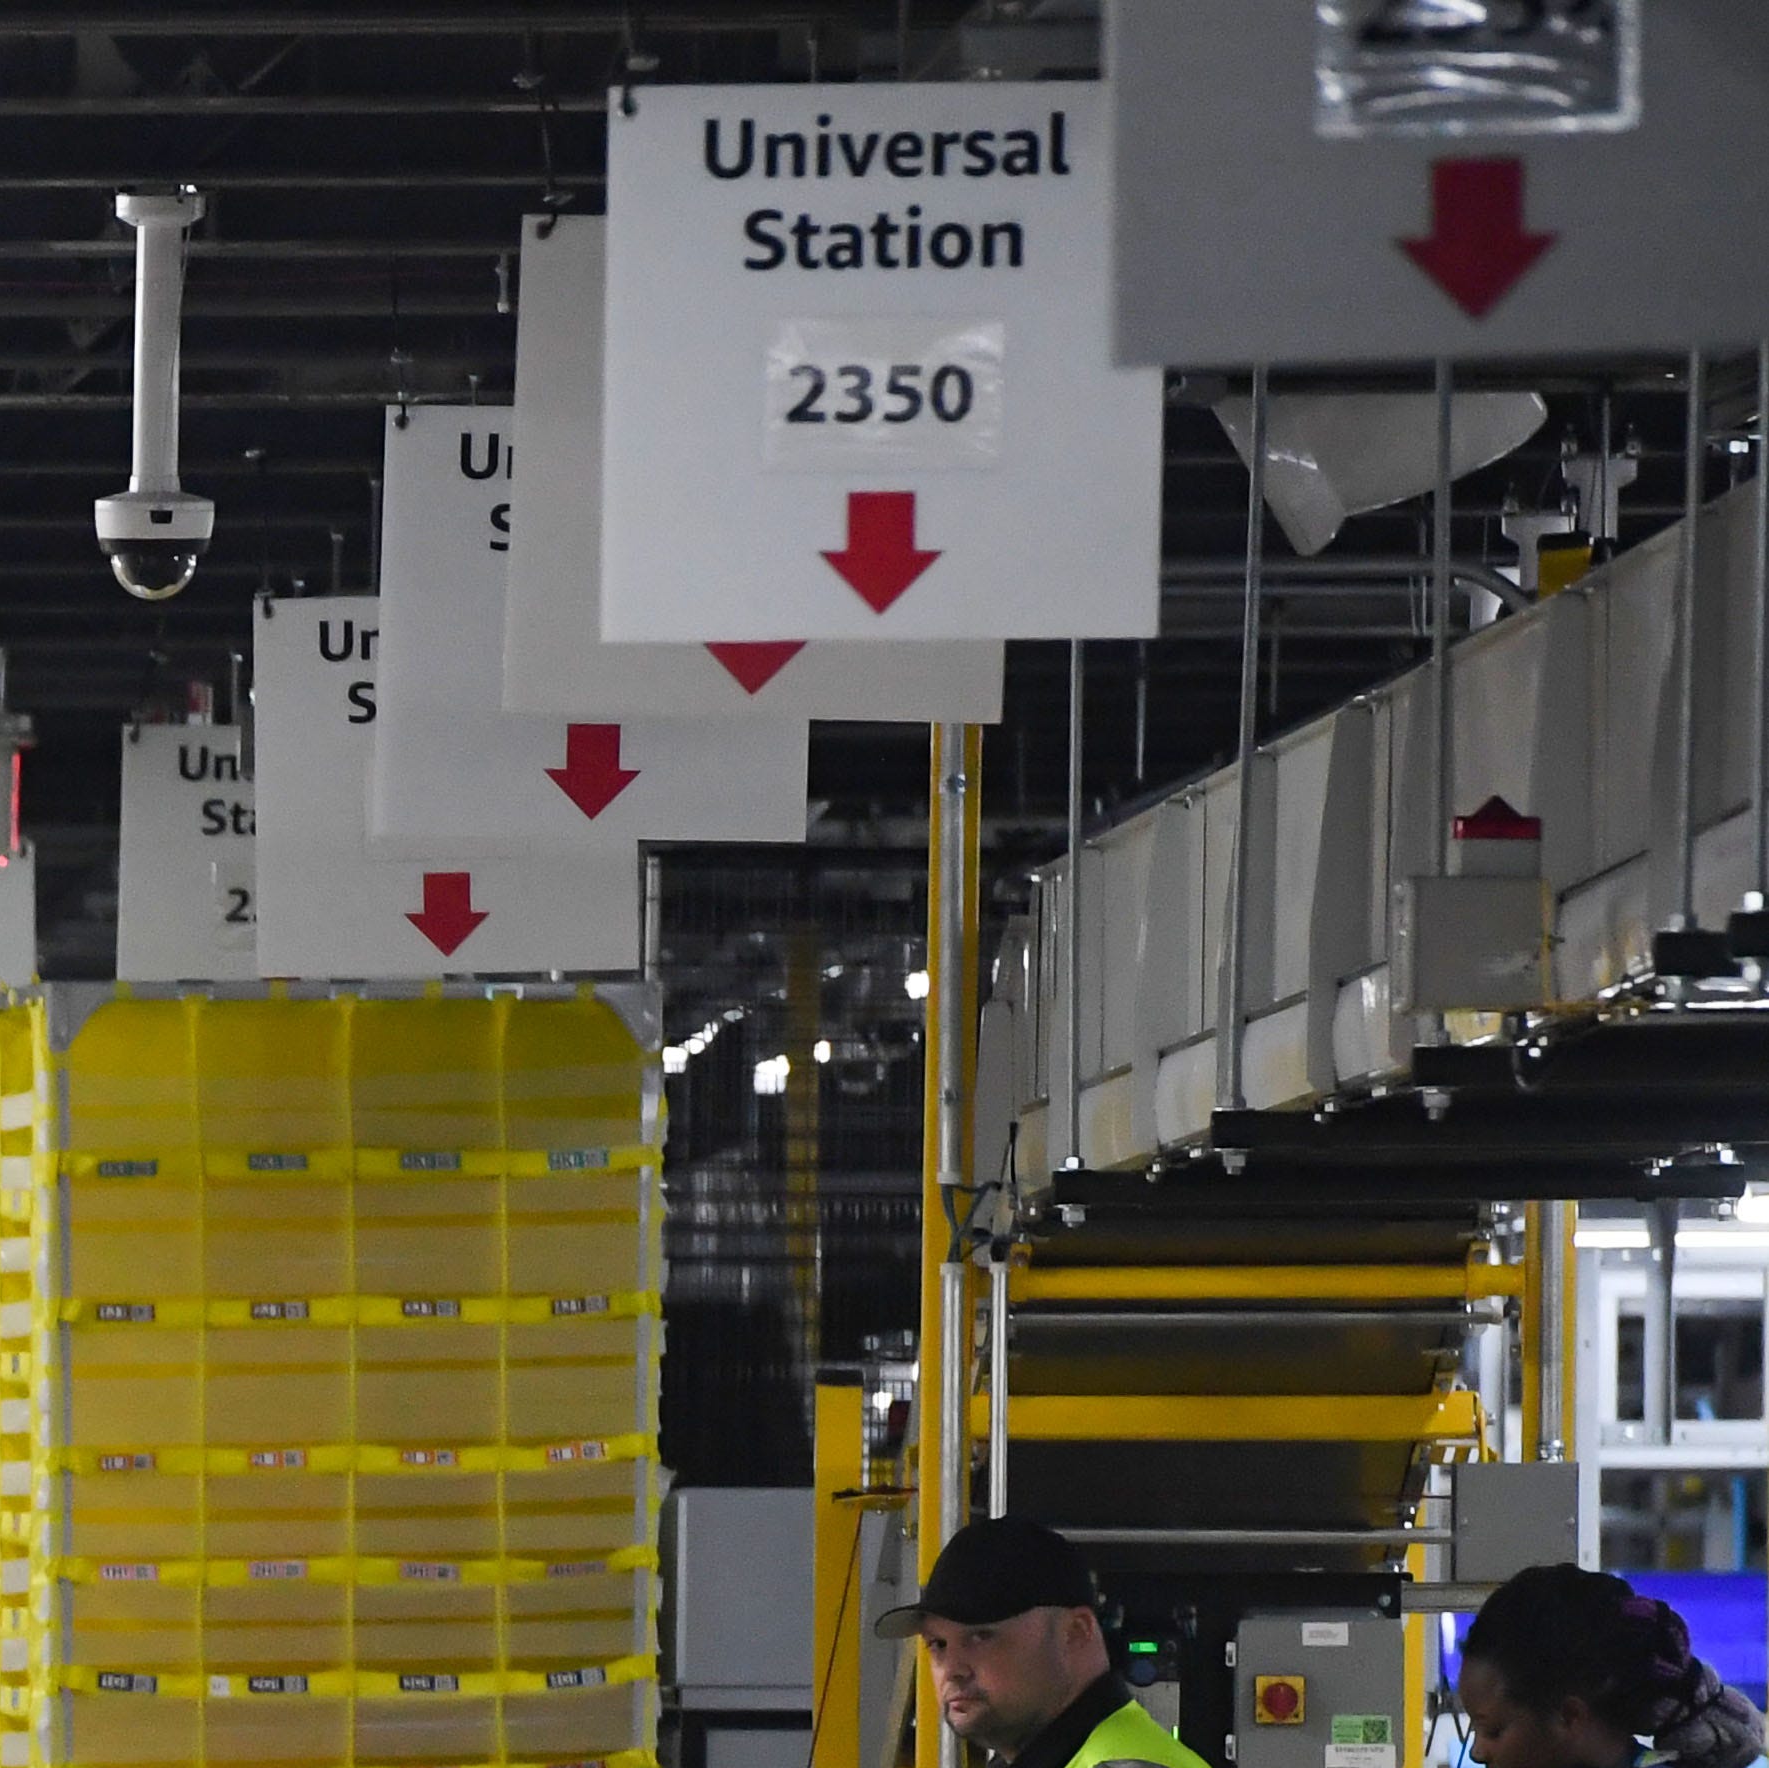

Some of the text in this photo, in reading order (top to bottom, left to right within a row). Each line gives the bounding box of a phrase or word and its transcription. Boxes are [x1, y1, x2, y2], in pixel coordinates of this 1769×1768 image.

[704, 111, 1071, 179] Universal
[743, 204, 1025, 271] Station
[785, 364, 973, 424] 2350
